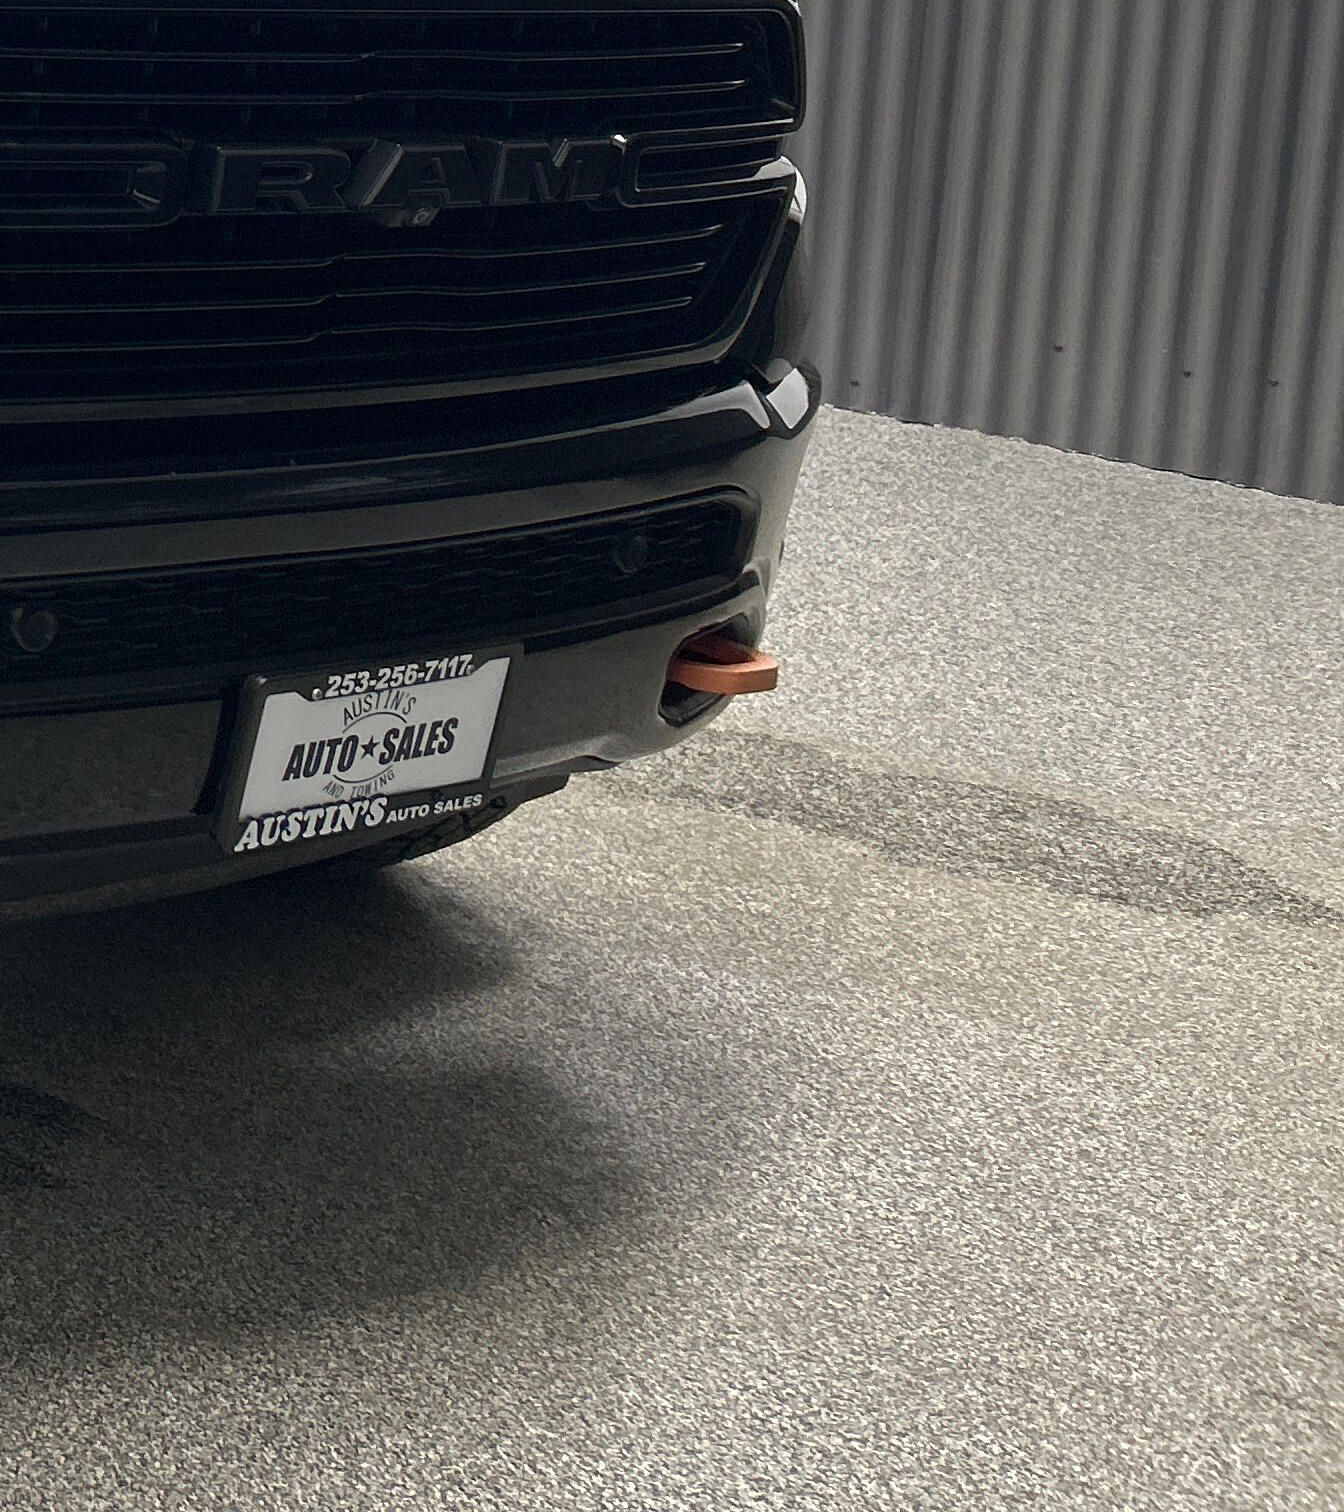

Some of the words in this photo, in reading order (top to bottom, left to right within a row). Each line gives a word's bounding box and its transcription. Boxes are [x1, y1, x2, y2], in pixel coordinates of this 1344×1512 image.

[210, 138, 620, 213] RAM
[325, 653, 473, 698] 253-256-7117
[342, 690, 417, 727] AUSTIN'S
[281, 734, 359, 782] AUTO
[379, 716, 460, 765] SALES
[322, 780, 345, 800] AND
[351, 770, 396, 800] TOWING
[233, 795, 388, 853] AUSTIN'S
[385, 805, 430, 824] AUTO
[433, 793, 483, 816] SALES
